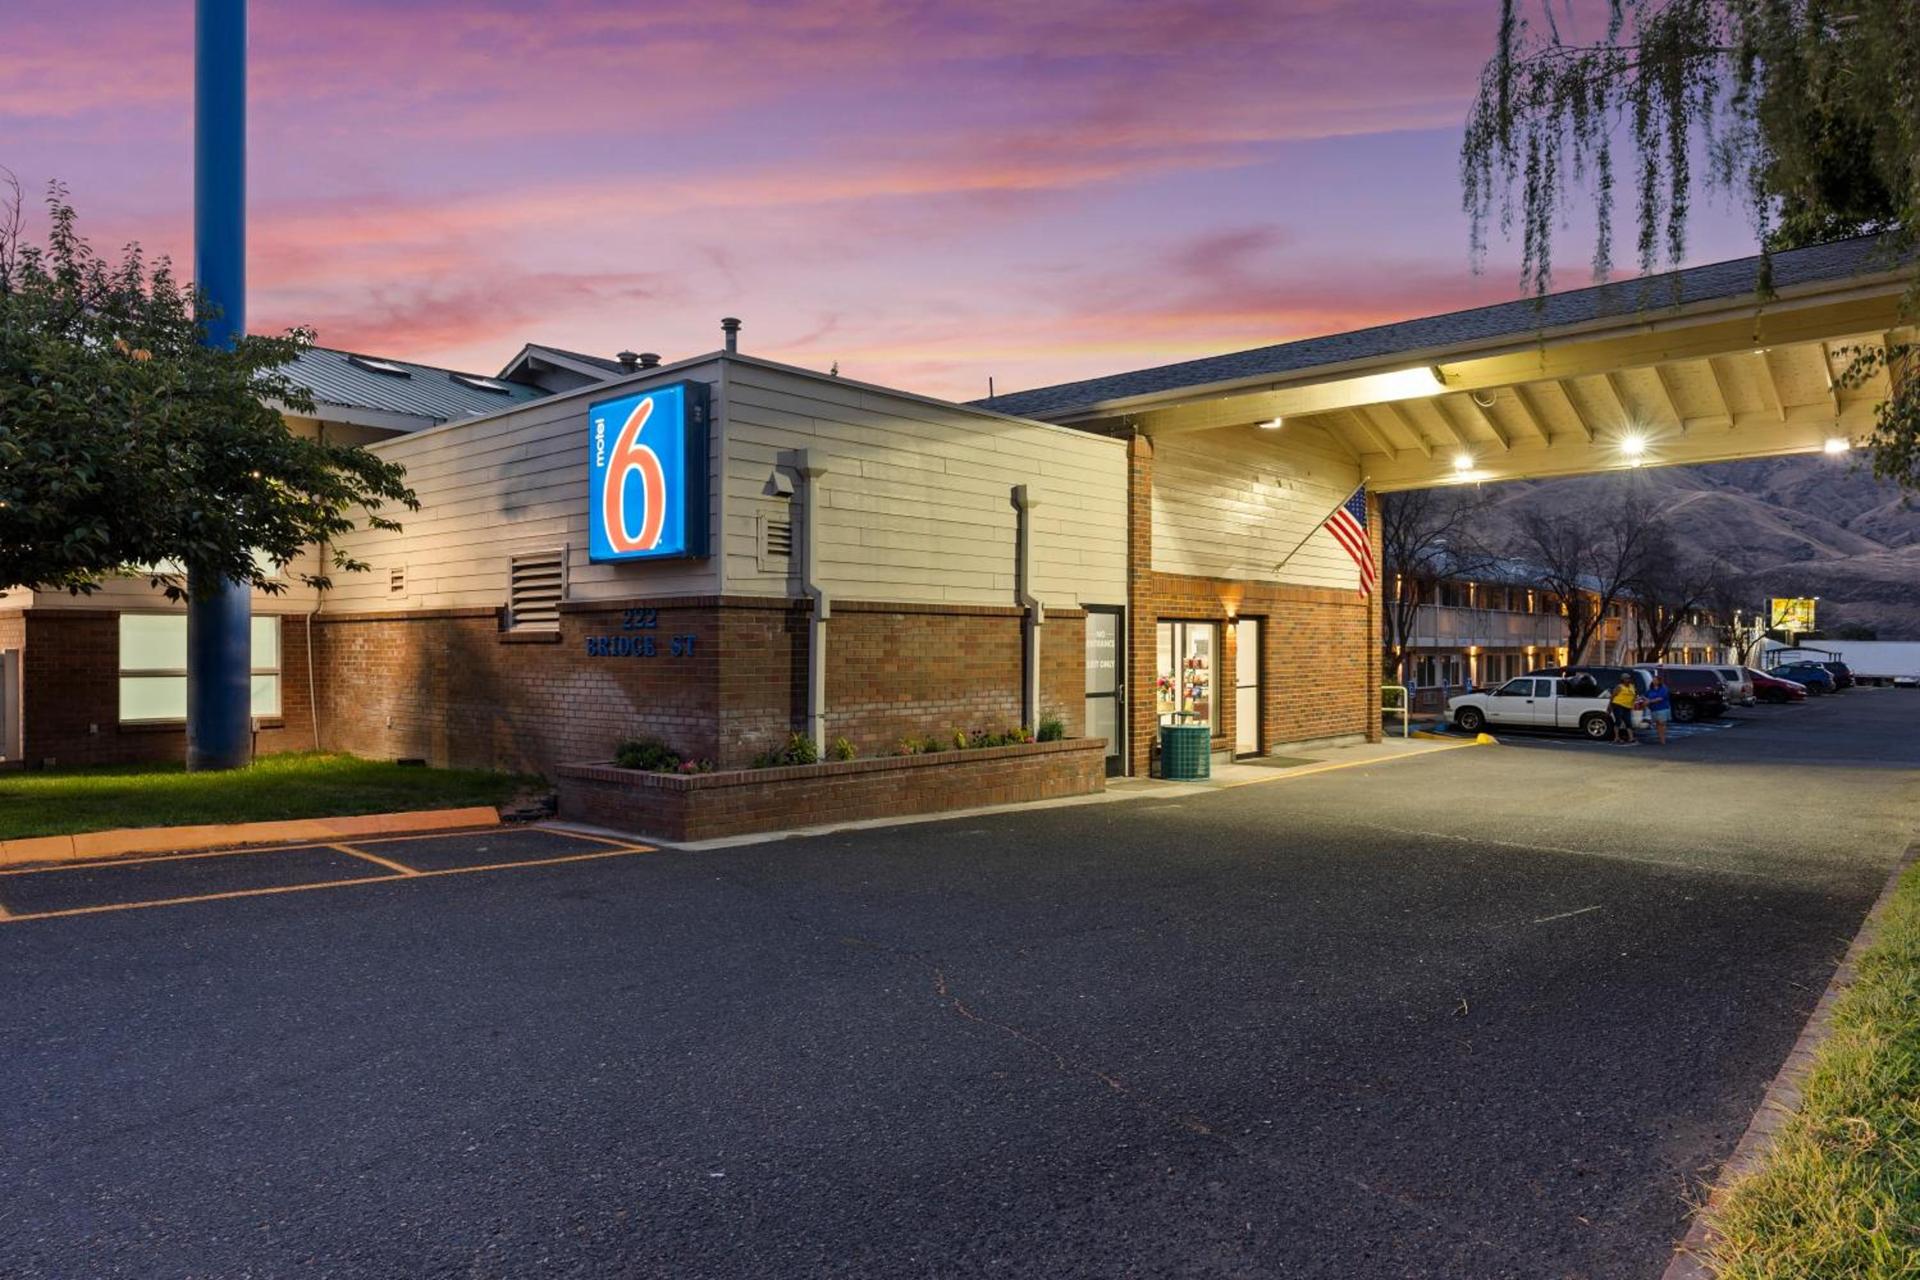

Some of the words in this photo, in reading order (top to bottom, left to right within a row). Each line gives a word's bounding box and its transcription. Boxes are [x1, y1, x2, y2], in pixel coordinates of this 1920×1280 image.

[595, 418, 605, 467] motel
[603, 397, 666, 553] 6
[623, 607, 657, 631] 222
[586, 634, 657, 657] BRIDGE
[670, 633, 697, 657] ST
